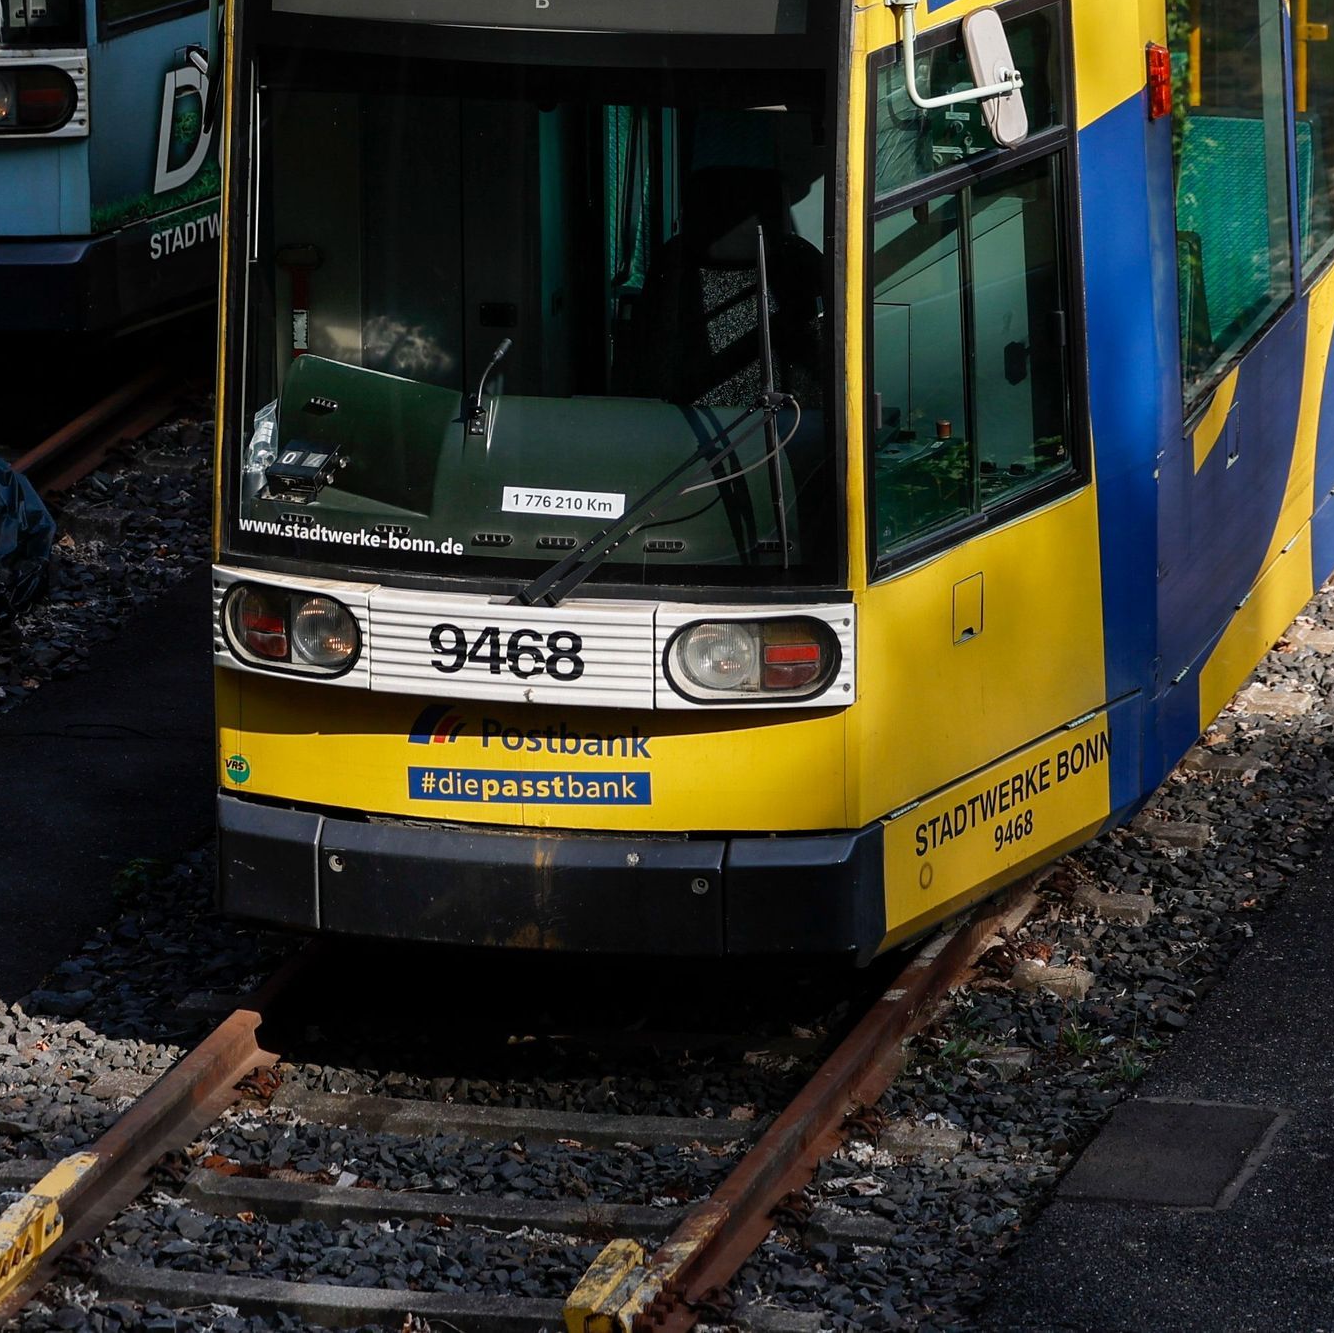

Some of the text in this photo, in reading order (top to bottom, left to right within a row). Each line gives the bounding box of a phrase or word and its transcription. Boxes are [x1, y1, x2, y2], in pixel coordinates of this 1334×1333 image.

[512, 494, 612, 512] 1 776 210 Km
[239, 518, 464, 555] www.stadtwerke-bonn.de
[429, 623, 585, 682] 9468
[482, 718, 652, 759] Postbank
[225, 758, 245, 771] VRS
[421, 771, 637, 801] #diepasstbank
[916, 727, 1112, 856] STADTWERKE BONN
[994, 809, 1034, 852] 9468
